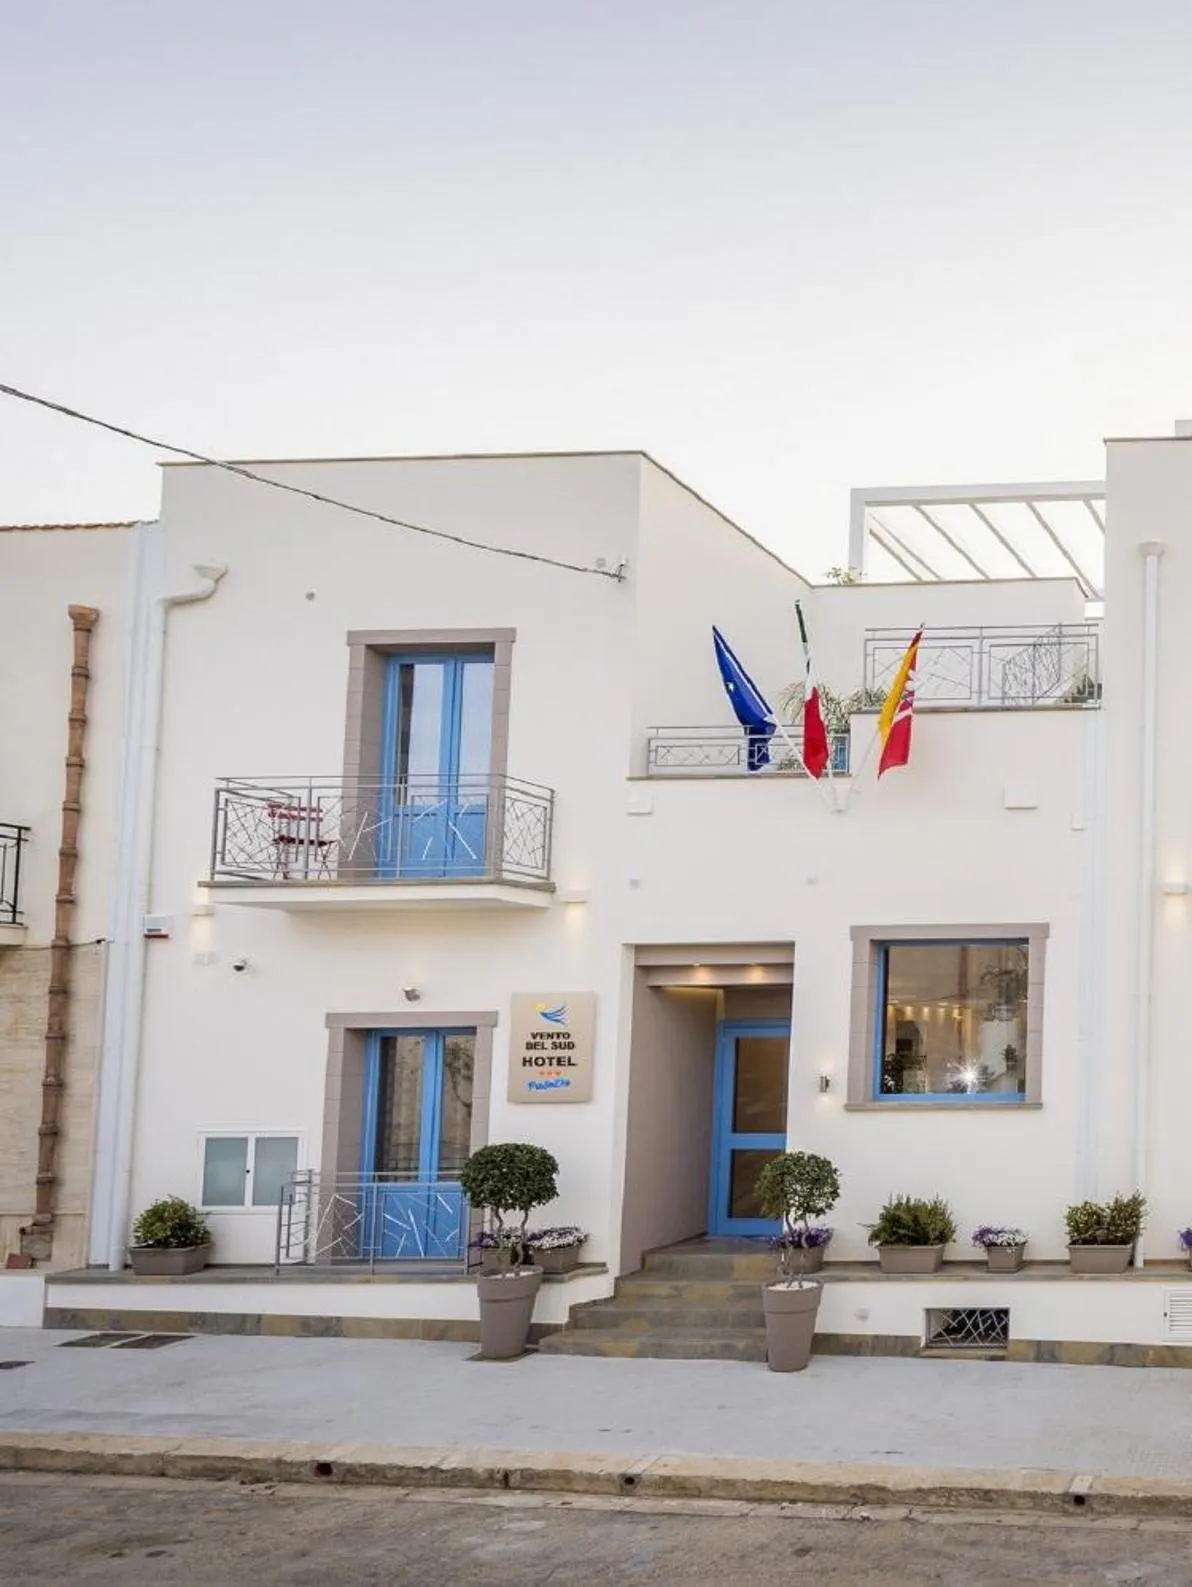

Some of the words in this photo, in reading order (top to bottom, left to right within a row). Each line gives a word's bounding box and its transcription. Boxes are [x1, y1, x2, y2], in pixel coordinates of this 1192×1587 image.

[530, 1031, 571, 1040] VENTO
[525, 1041, 548, 1050] DEL
[551, 1041, 575, 1050] SUD
[522, 1056, 578, 1067] HOTEL
